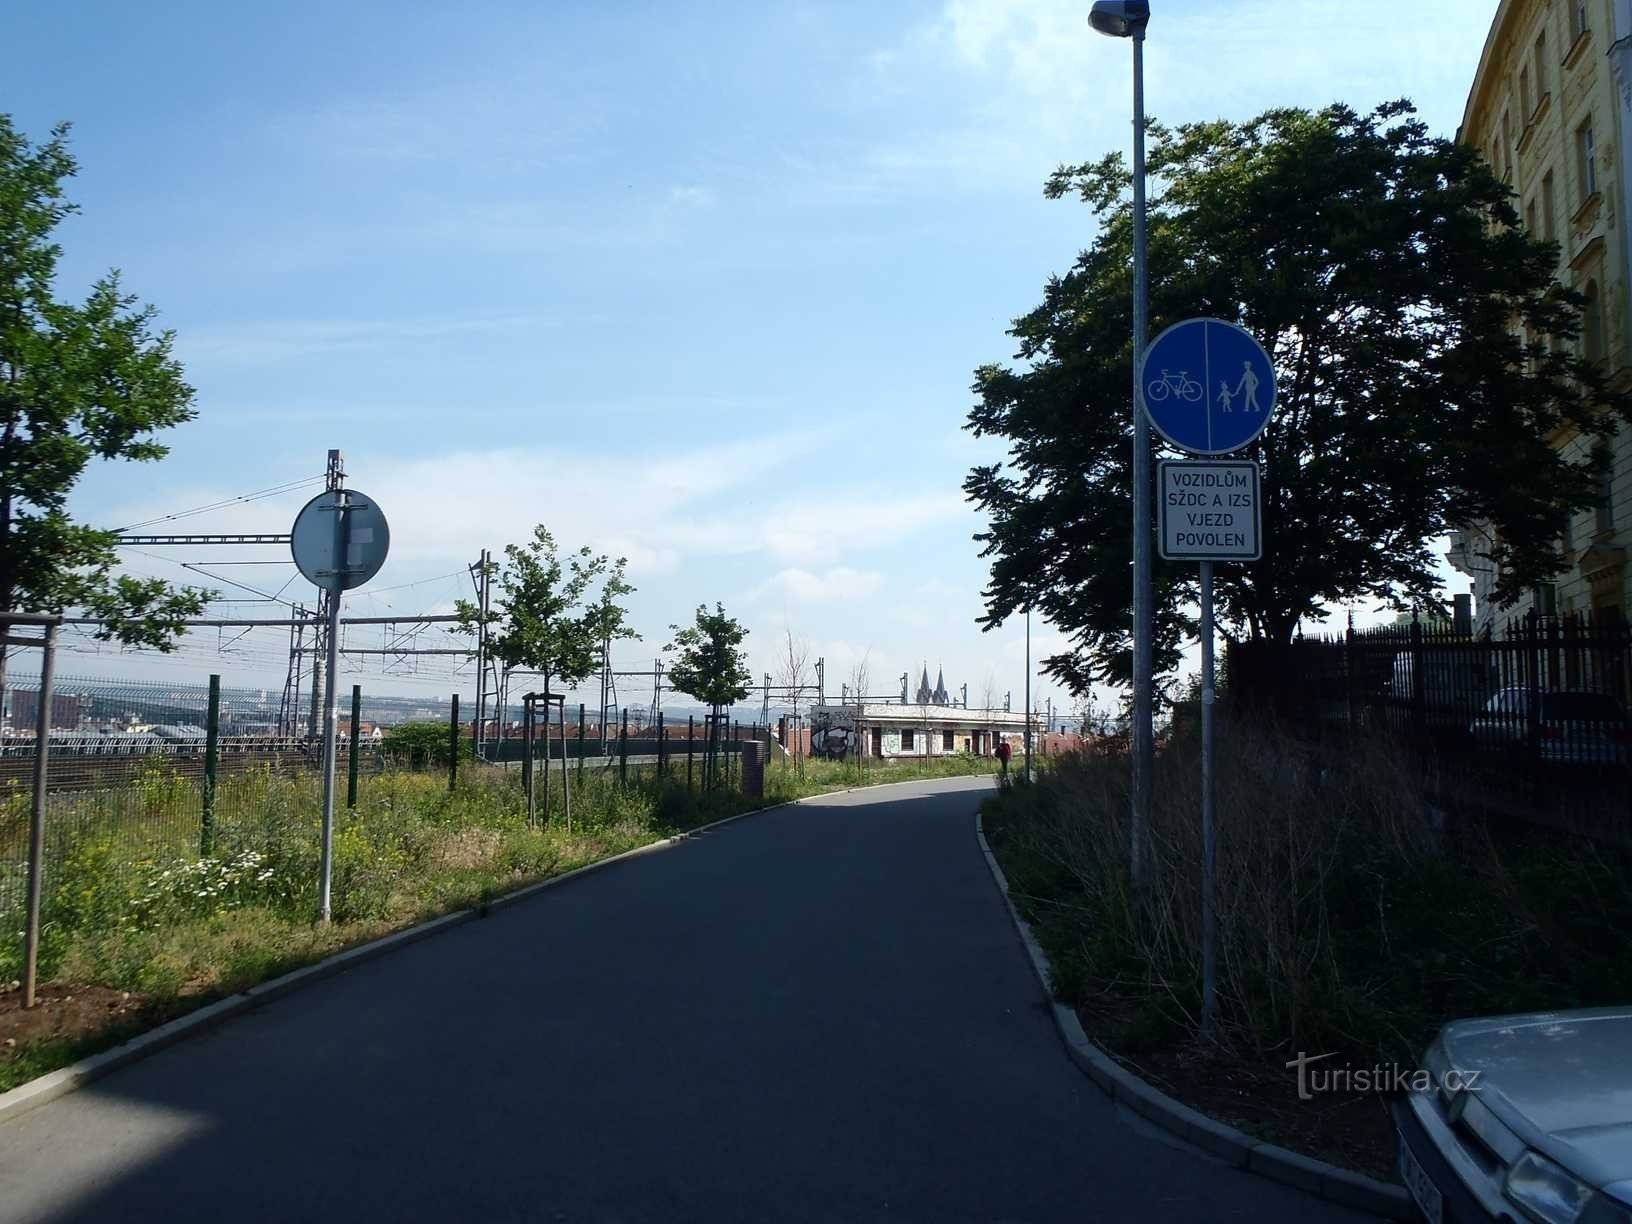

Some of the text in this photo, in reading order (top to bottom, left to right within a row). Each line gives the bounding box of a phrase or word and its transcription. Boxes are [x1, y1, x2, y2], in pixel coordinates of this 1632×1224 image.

[1172, 471, 1247, 488] VOZIDLŮM
[1168, 489, 1251, 508] SŽDC A IZS
[1187, 513, 1234, 527] VJEZD
[1176, 532, 1245, 547] POVOLEN
